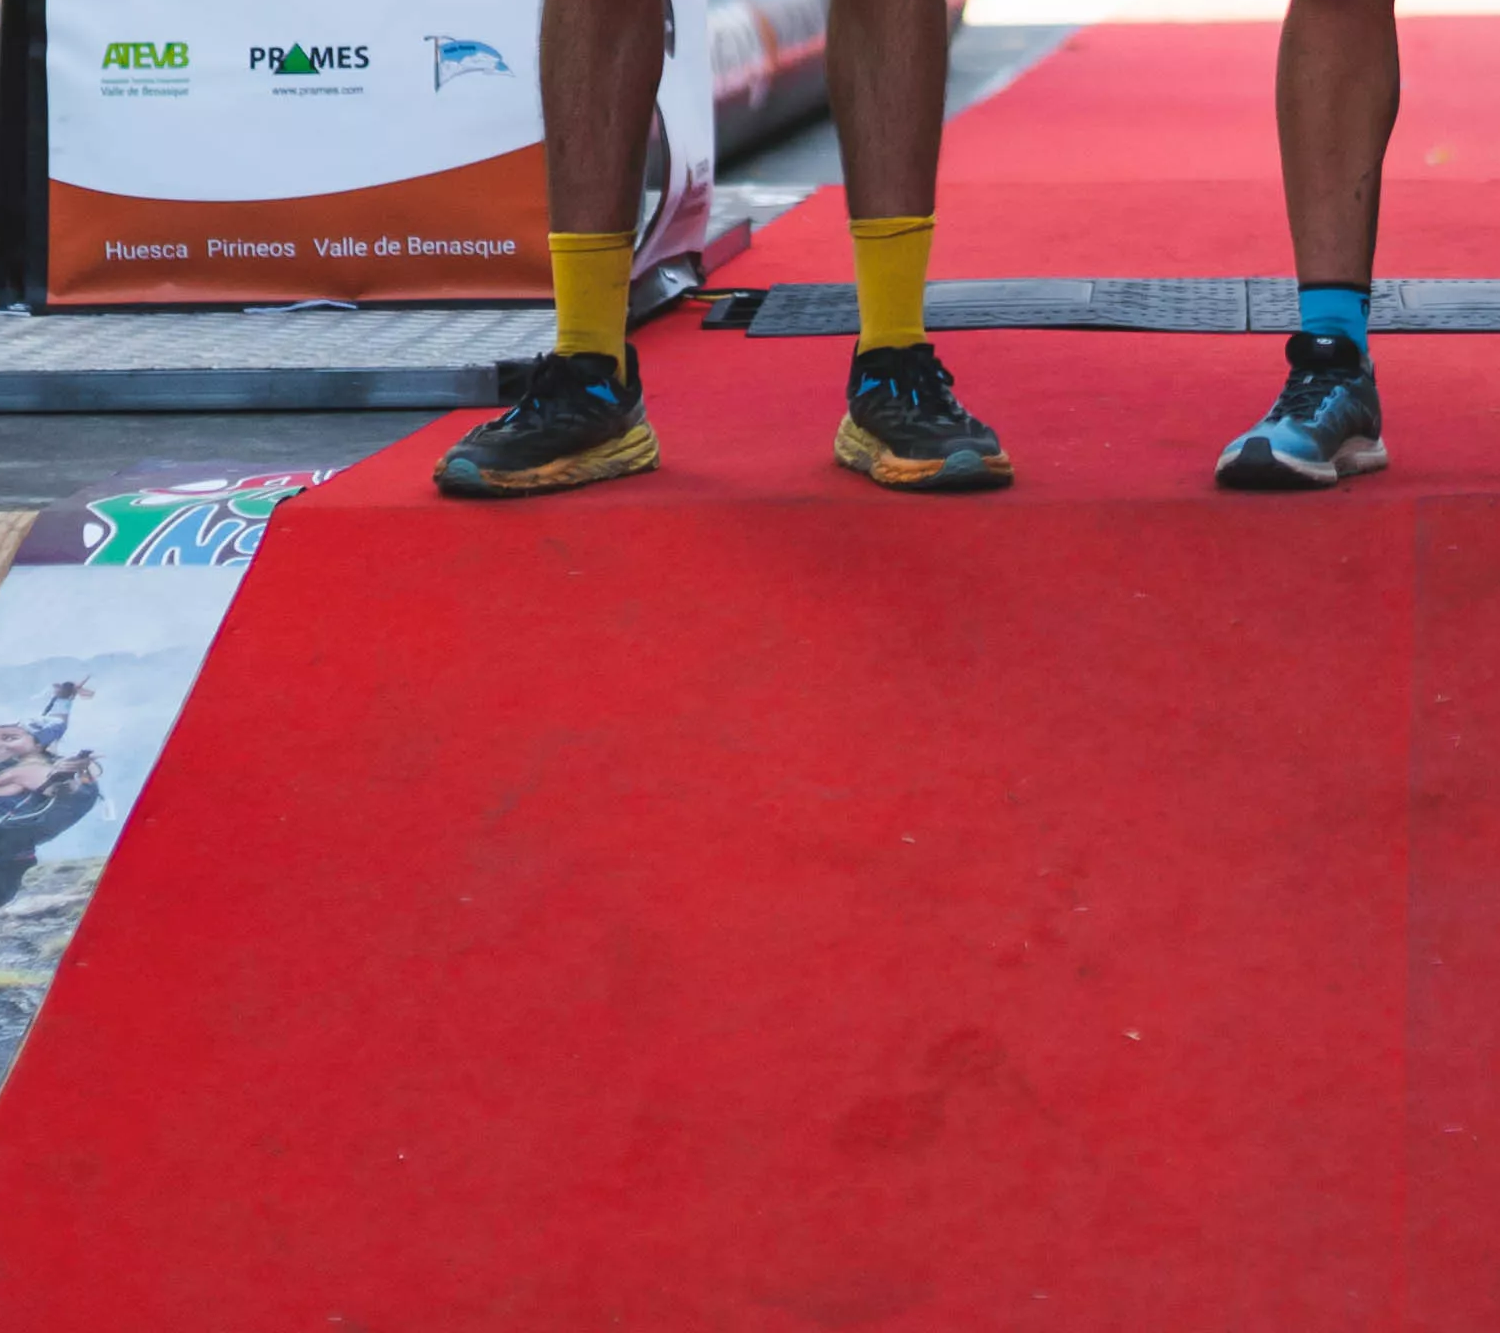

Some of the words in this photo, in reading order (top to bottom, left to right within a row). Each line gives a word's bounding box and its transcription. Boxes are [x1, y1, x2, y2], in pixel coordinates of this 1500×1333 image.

[249, 42, 370, 74] PRAMES
[100, 86, 125, 97] Valle
[105, 239, 189, 261] Huesca
[206, 237, 296, 258] Pirineos
[313, 236, 369, 257] Valle
[374, 236, 401, 257] de
[407, 235, 516, 260] Benasque
